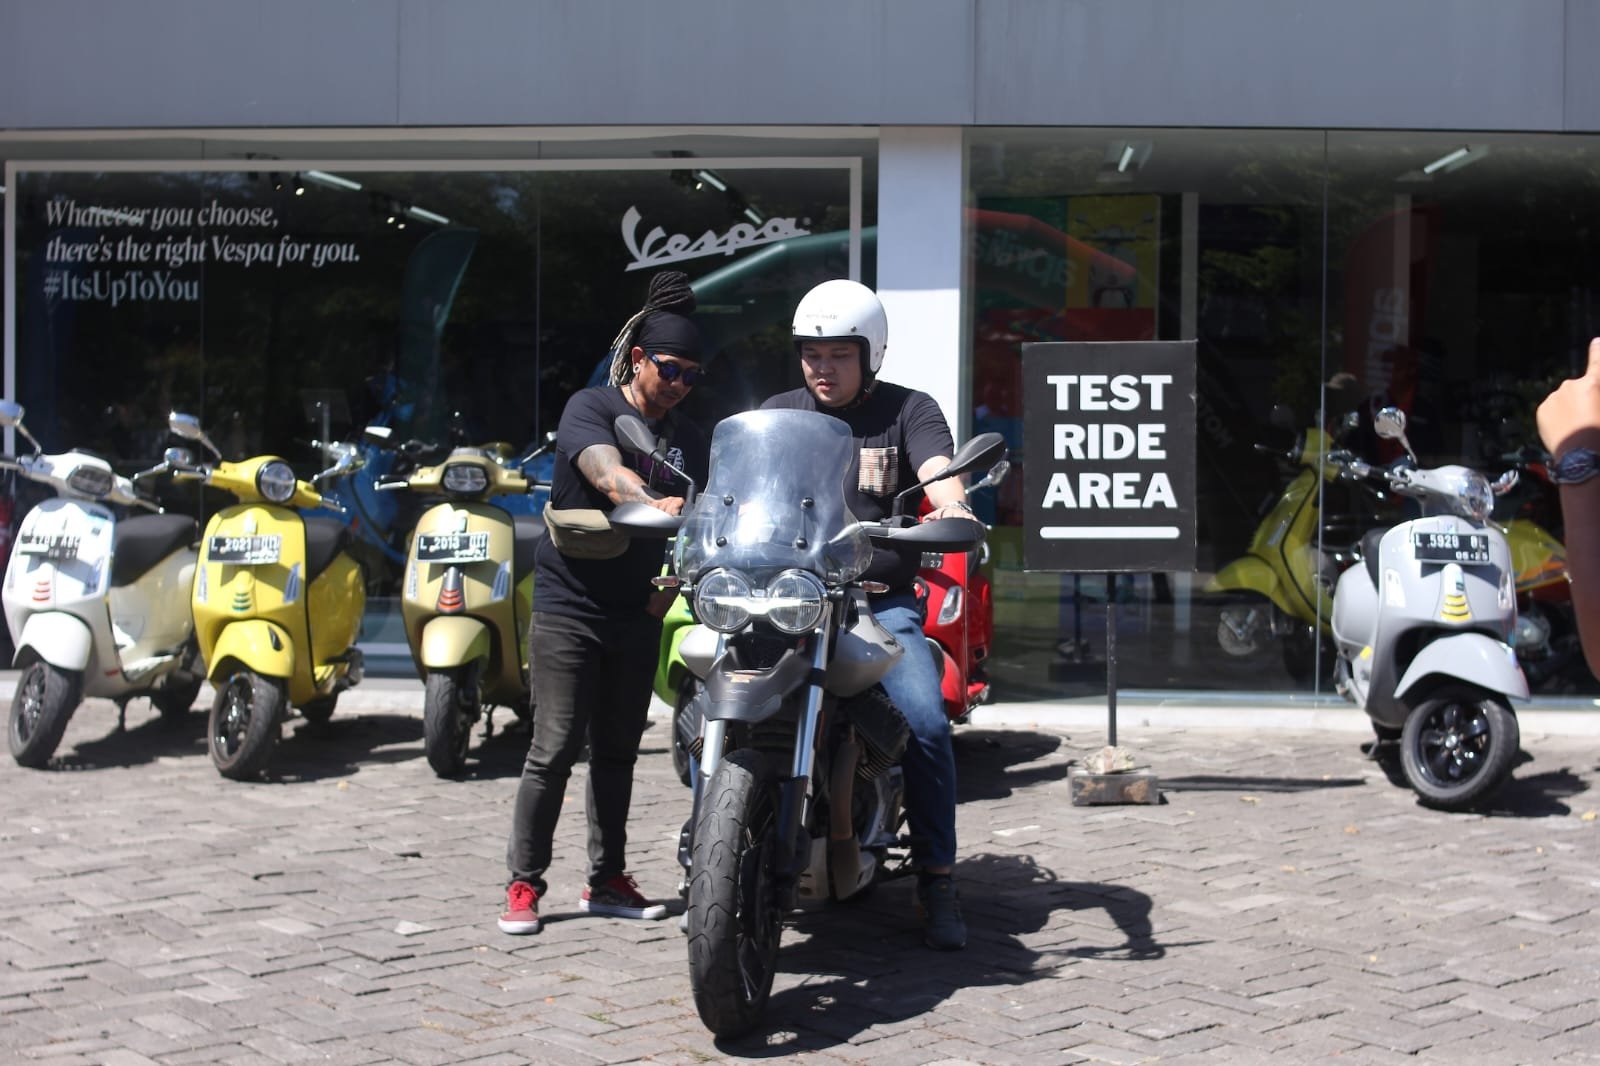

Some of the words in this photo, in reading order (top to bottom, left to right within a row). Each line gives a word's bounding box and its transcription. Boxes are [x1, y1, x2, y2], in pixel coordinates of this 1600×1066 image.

[150, 206, 196, 231] you
[197, 200, 280, 229] choose,
[45, 235, 113, 263] there's
[116, 235, 154, 262] the
[154, 235, 207, 267] right
[211, 238, 274, 267] Vespa
[276, 234, 311, 267] for
[311, 241, 361, 267] you.
[621, 205, 811, 272] Vespa
[43, 269, 200, 307] #ItsUpToYou
[1047, 375, 1173, 410] TEST
[1054, 424, 1167, 459] RIDE
[1042, 473, 1178, 508] AREA
[211, 537, 218, 551] L
[420, 537, 427, 549] L
[1415, 534, 1423, 547] L
